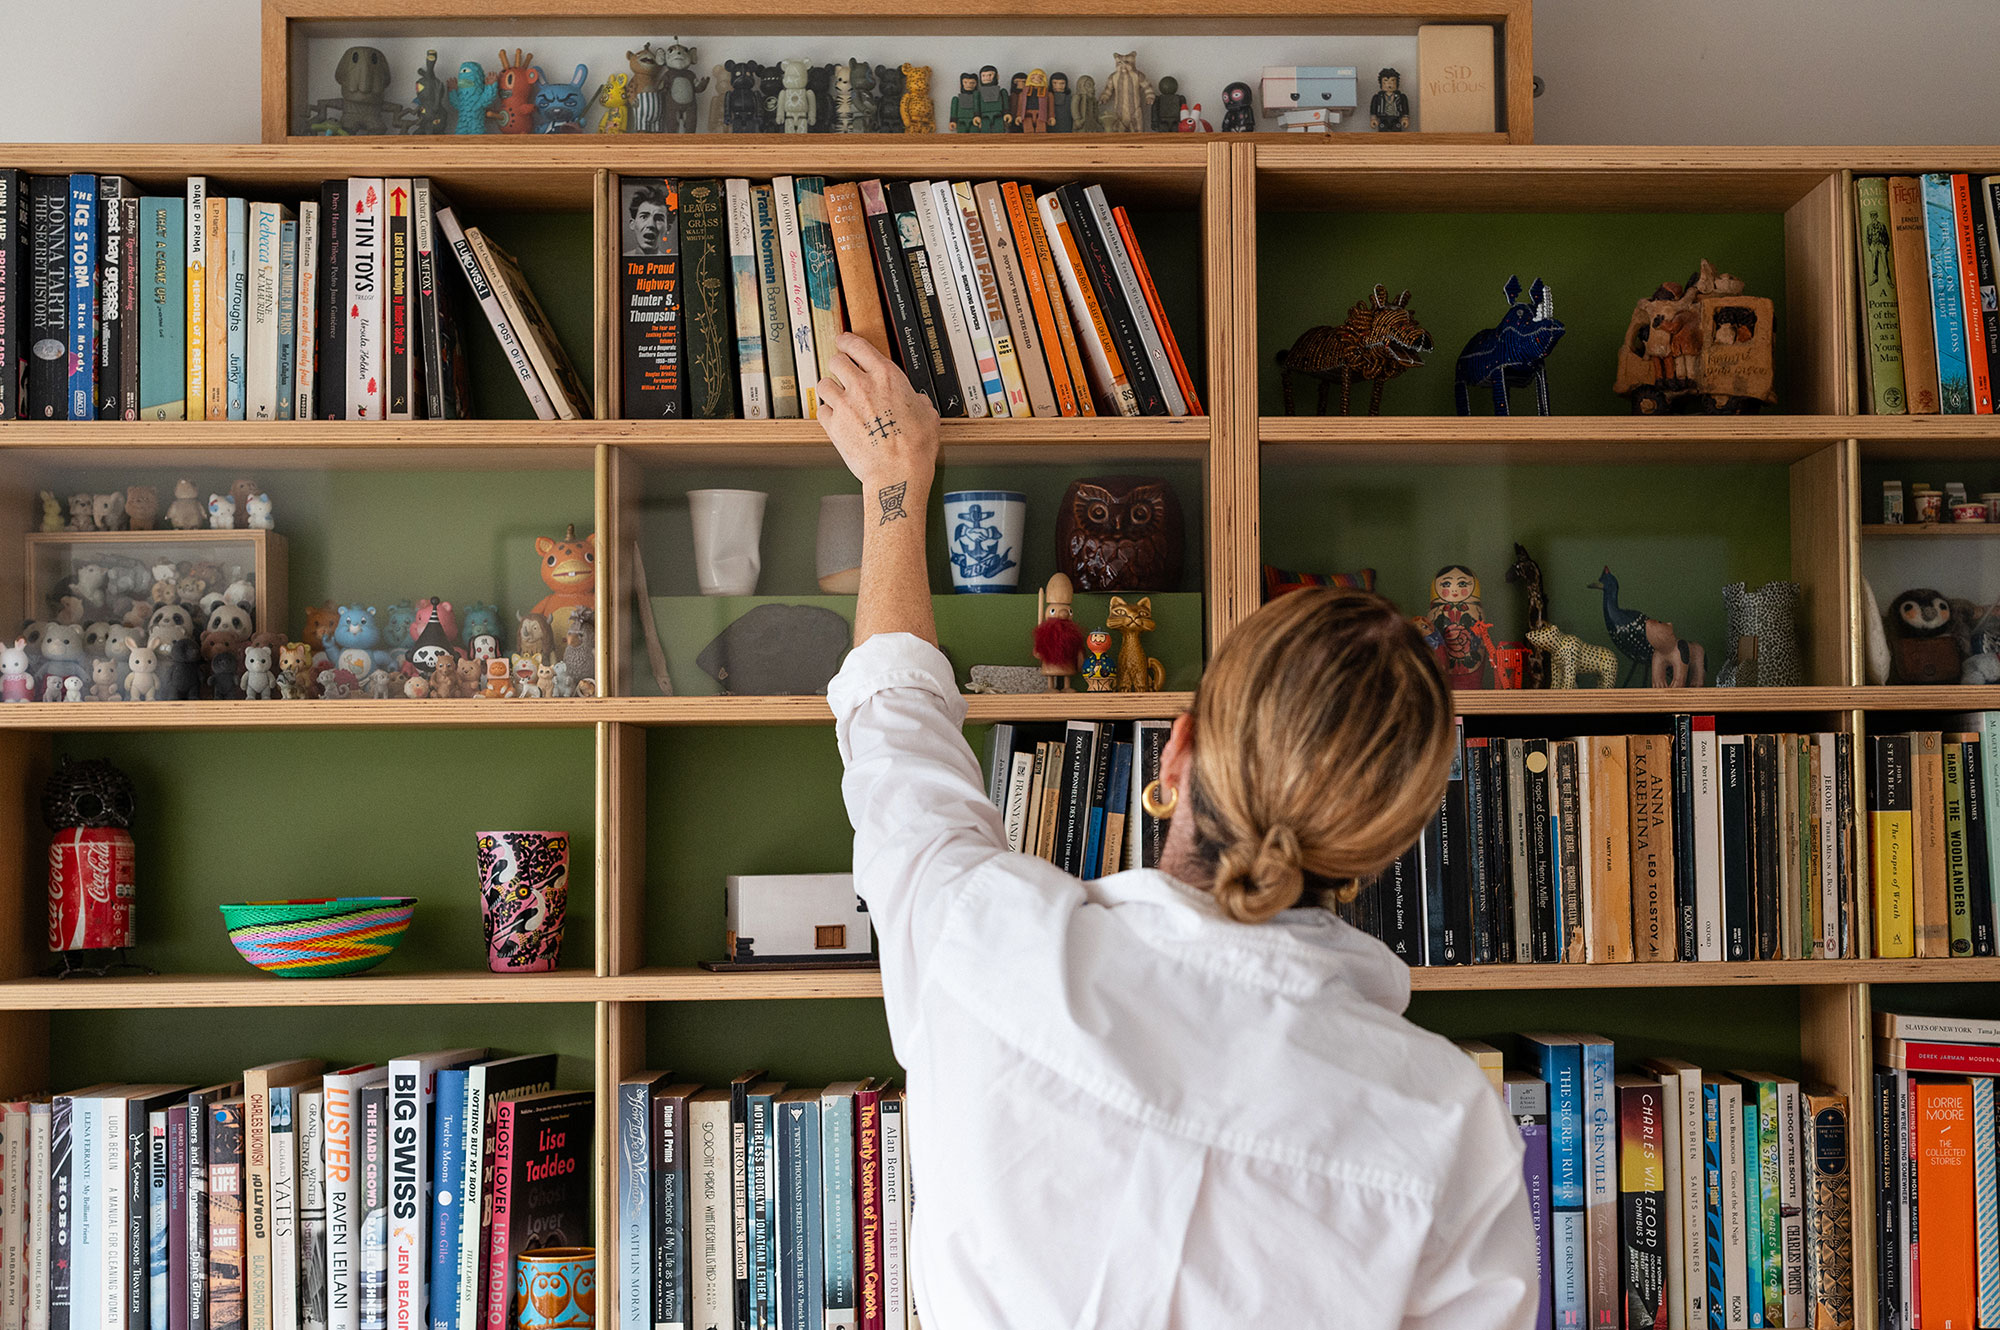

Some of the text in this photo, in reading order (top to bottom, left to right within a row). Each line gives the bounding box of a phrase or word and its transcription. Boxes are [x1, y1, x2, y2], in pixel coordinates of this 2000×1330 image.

[73, 191, 92, 201] THE
[157, 209, 166, 238] WHAT
[193, 184, 201, 210] DIANE
[418, 190, 428, 249] Barbara Comyns
[683, 204, 716, 212] LEAVES
[689, 219, 718, 227] GRASS
[1960, 186, 1974, 265] ROLAND BARTHES
[73, 203, 90, 288] ICE STORM
[192, 225, 201, 252] PRIMA
[259, 210, 276, 263] Rebecca
[355, 216, 374, 292] TIN TOYS
[756, 190, 775, 283] Frank Norman
[1024, 192, 1049, 262] Beryl Bainbridge
[34, 195, 47, 330] THE SECRET HISTORY
[48, 196, 65, 330] DONNA TARTT
[104, 199, 119, 320] east bay grease
[155, 251, 166, 283] CARVE
[280, 241, 294, 335] THAT SUMMER IN PARIS
[457, 241, 489, 296] BUKOWSKI
[628, 262, 675, 275] The Proud
[636, 279, 675, 292] Highway
[962, 207, 1003, 322] JOHN FANTE
[1941, 220, 1960, 352] THE MILL ON THE FLOSS
[154, 288, 166, 304] UP!
[256, 269, 265, 323] DU MAURIER
[265, 278, 273, 315] DAPHNE
[630, 310, 675, 322] Thompson
[631, 294, 675, 307] Hunter S.
[76, 335, 85, 372] Moody
[229, 273, 245, 384] Burroughs Junky
[497, 322, 531, 381] POST OFFICE
[904, 327, 919, 369] david sedaris
[1119, 320, 1146, 381] IAN HAMILTON
[76, 392, 84, 415] ABACUS
[1635, 754, 1648, 850] KARENINA
[1651, 775, 1664, 828] ANNA
[1887, 743, 1895, 806] STEINBECK
[1534, 778, 1548, 909] Tropic of Capricorn Henry Miller
[1891, 843, 1900, 875] Grapes
[1948, 753, 1965, 916] HARDY THE WOODLANDERS
[1648, 854, 1658, 940] LEO TOLSTOY
[1893, 879, 1900, 888] of
[394, 1074, 416, 1121] BIG
[1593, 1060, 1607, 1194] KATE GRENVILLE
[1926, 1110, 1964, 1120] MOORE
[1927, 1098, 1964, 1108] LORRIE
[108, 1115, 118, 1170] LUCIA BERLIN
[154, 1136, 165, 1188] Lowlife
[367, 1103, 377, 1207] THE HARD CROWD
[442, 1115, 452, 1182] Twelve Moons
[469, 1088, 479, 1204] NOTHING BUT MY BODY
[538, 1128, 565, 1152] Lisa
[1560, 1068, 1573, 1199] THE SECRET RIVER
[251, 1094, 265, 1238] CHARLES BUKOWSKI HOLLYWOOD
[394, 1127, 416, 1219] SWISS
[526, 1153, 575, 1181] Taddeo
[887, 1127, 897, 1202] Alan Bennett
[1642, 1094, 1656, 1248] CHARLES WILLEFORD
[59, 1176, 67, 1245] HOBO
[275, 1177, 292, 1237] YATES
[327, 1088, 350, 1309] LUSTER RAVEN LEILANI
[490, 1107, 510, 1324] GHOST LOVER LISA TADDEO
[754, 1105, 766, 1300] MOTHERLESS BROOKLYN JONATHAN LETHEM
[859, 1103, 878, 1319] The Early Stories of Truman Capote
[1635, 1198, 1643, 1236] OMNIBUS
[398, 1246, 408, 1276] JEN
[439, 1213, 449, 1263] Caro Giles
[1565, 1217, 1575, 1302] KATE GRENVILLE
[1788, 1225, 1801, 1295] CHARLES PORTIS
[631, 1224, 640, 1322] CAITLIN MORAN
